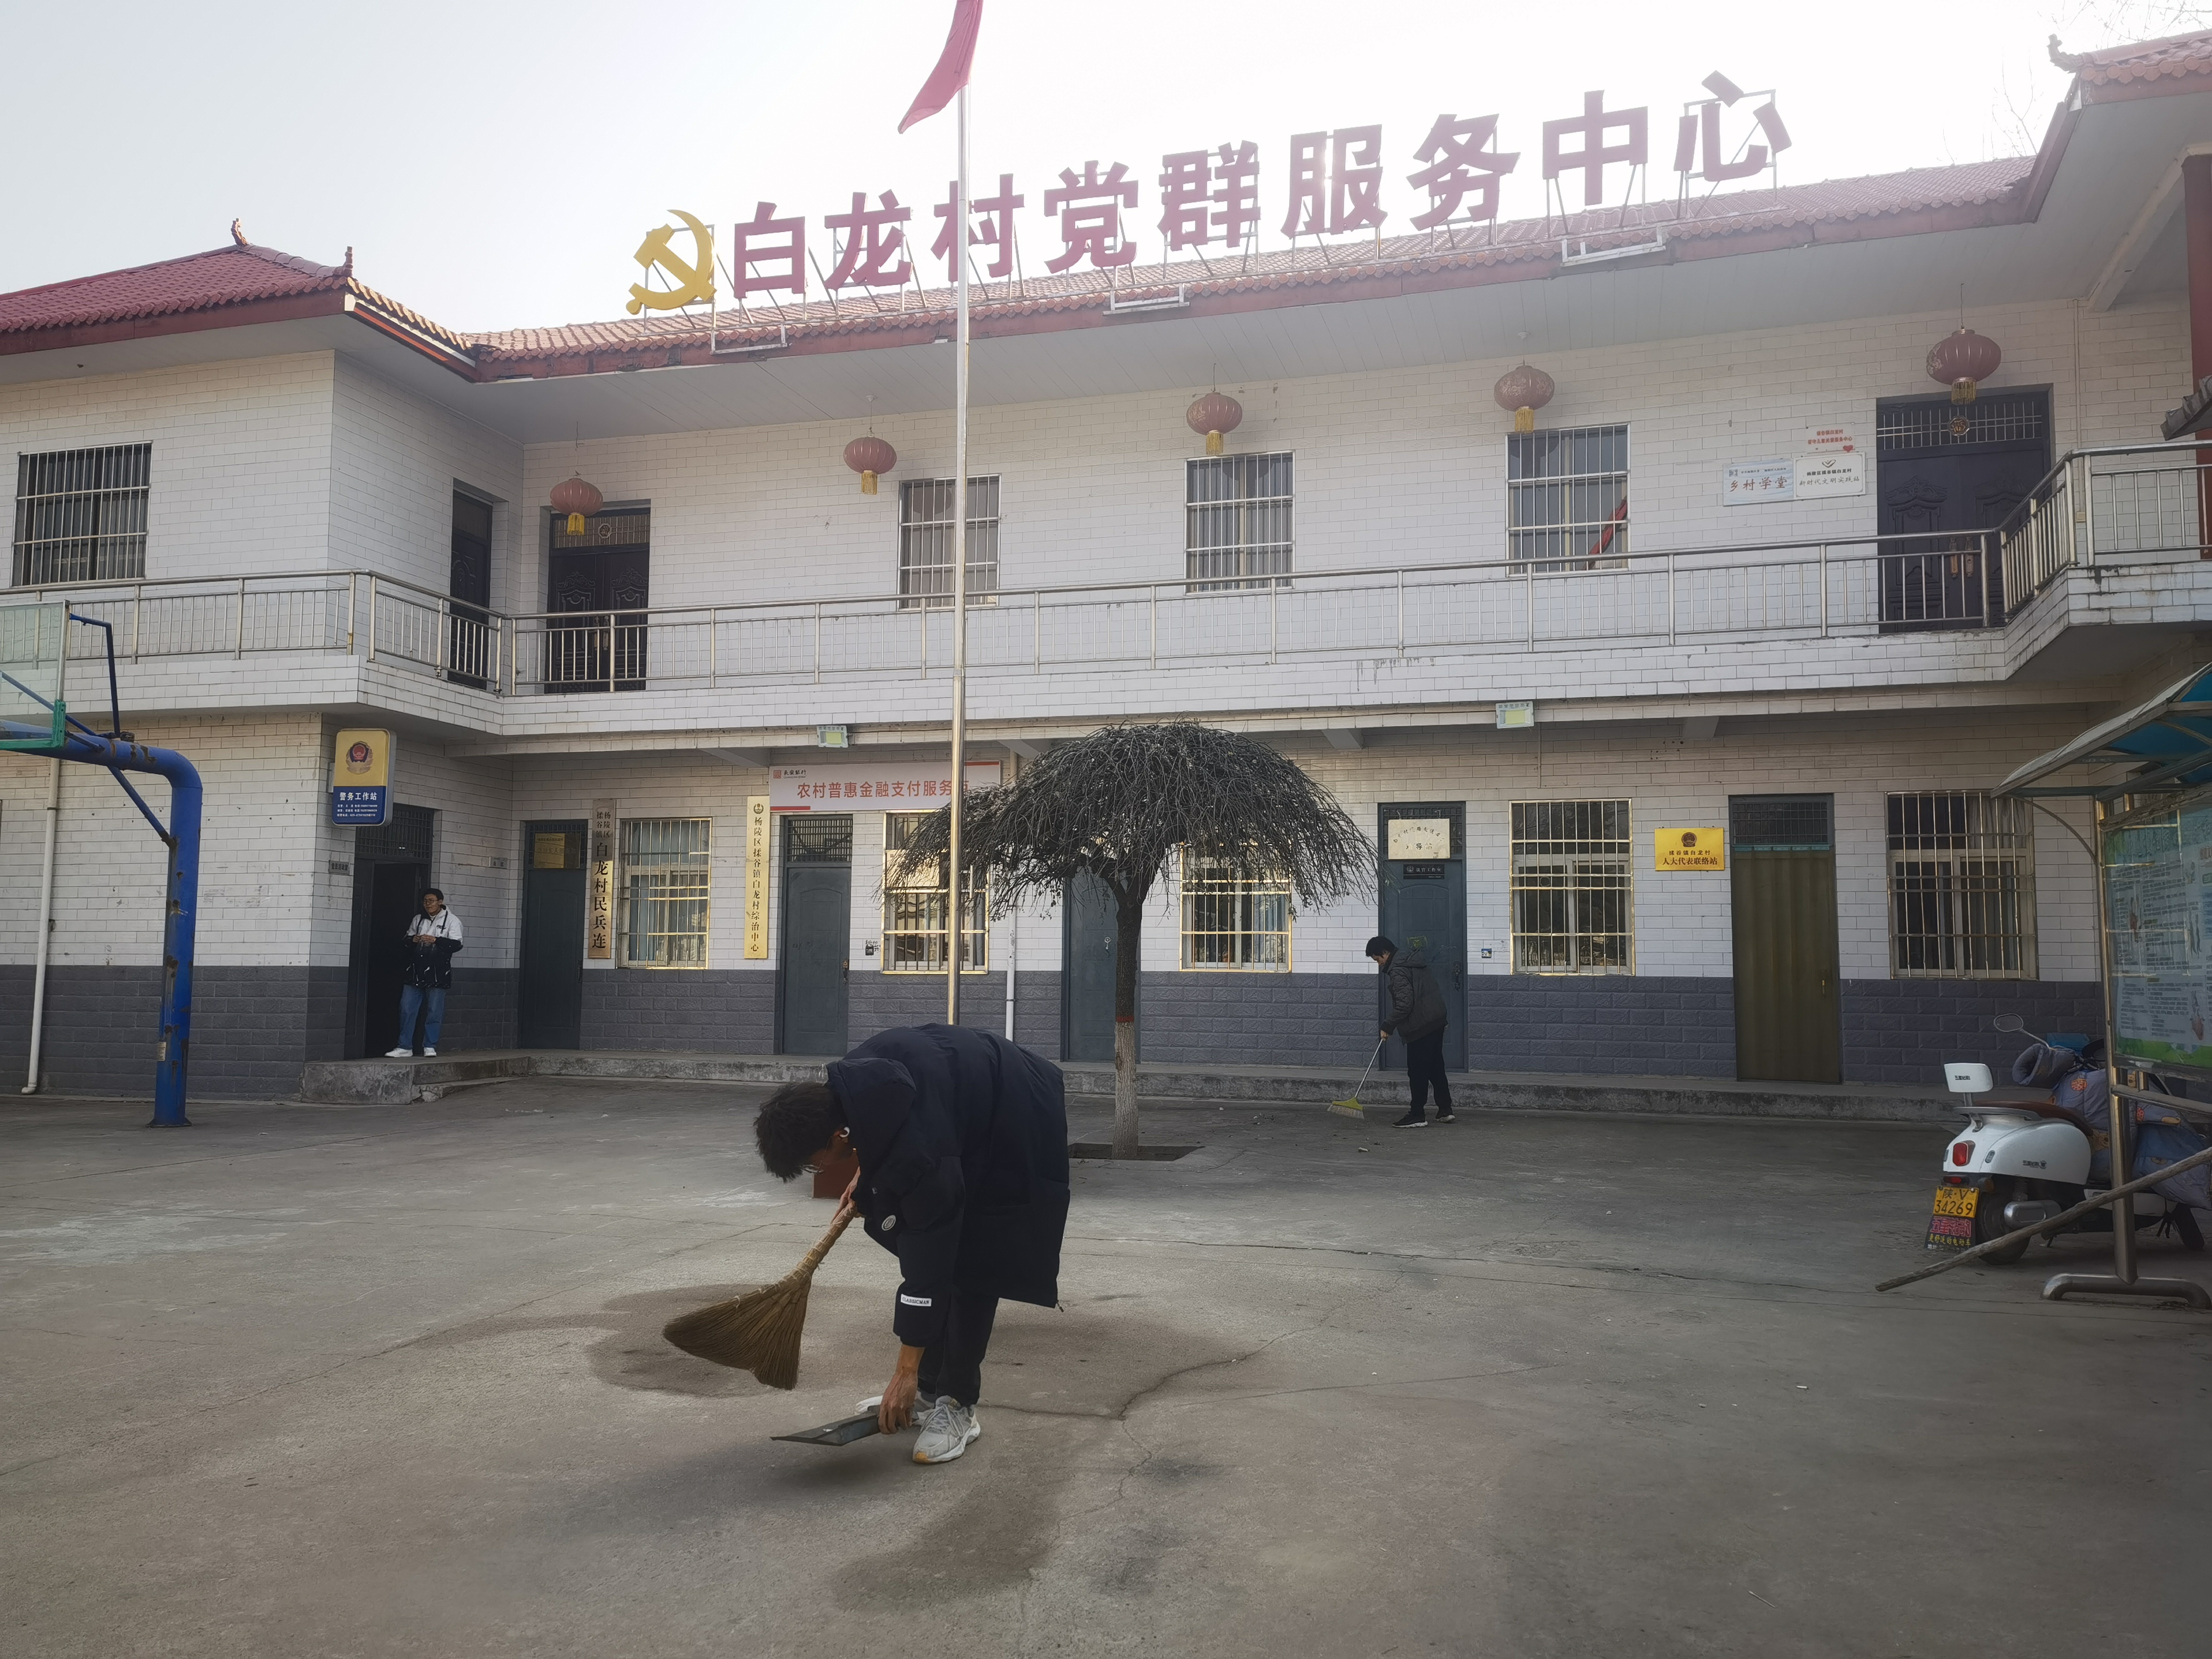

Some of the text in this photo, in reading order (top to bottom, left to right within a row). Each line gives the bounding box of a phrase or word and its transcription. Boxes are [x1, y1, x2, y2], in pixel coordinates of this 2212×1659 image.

[734, 70, 1792, 298] 白龙村党群服务中心
[1729, 476, 1787, 492] 乡村学堂
[340, 792, 377, 801] 警务工作站
[1662, 857, 1718, 865] 人大代表联络站
[750, 817, 763, 952] 杨陵区揉谷镇白龙村综治中心
[592, 842, 609, 949] 白龙村民兵连
[1943, 1189, 1970, 1200] 陕·V
[1935, 1200, 1973, 1216] 34269
[902, 1297, 929, 1305] CLASSICMAN
